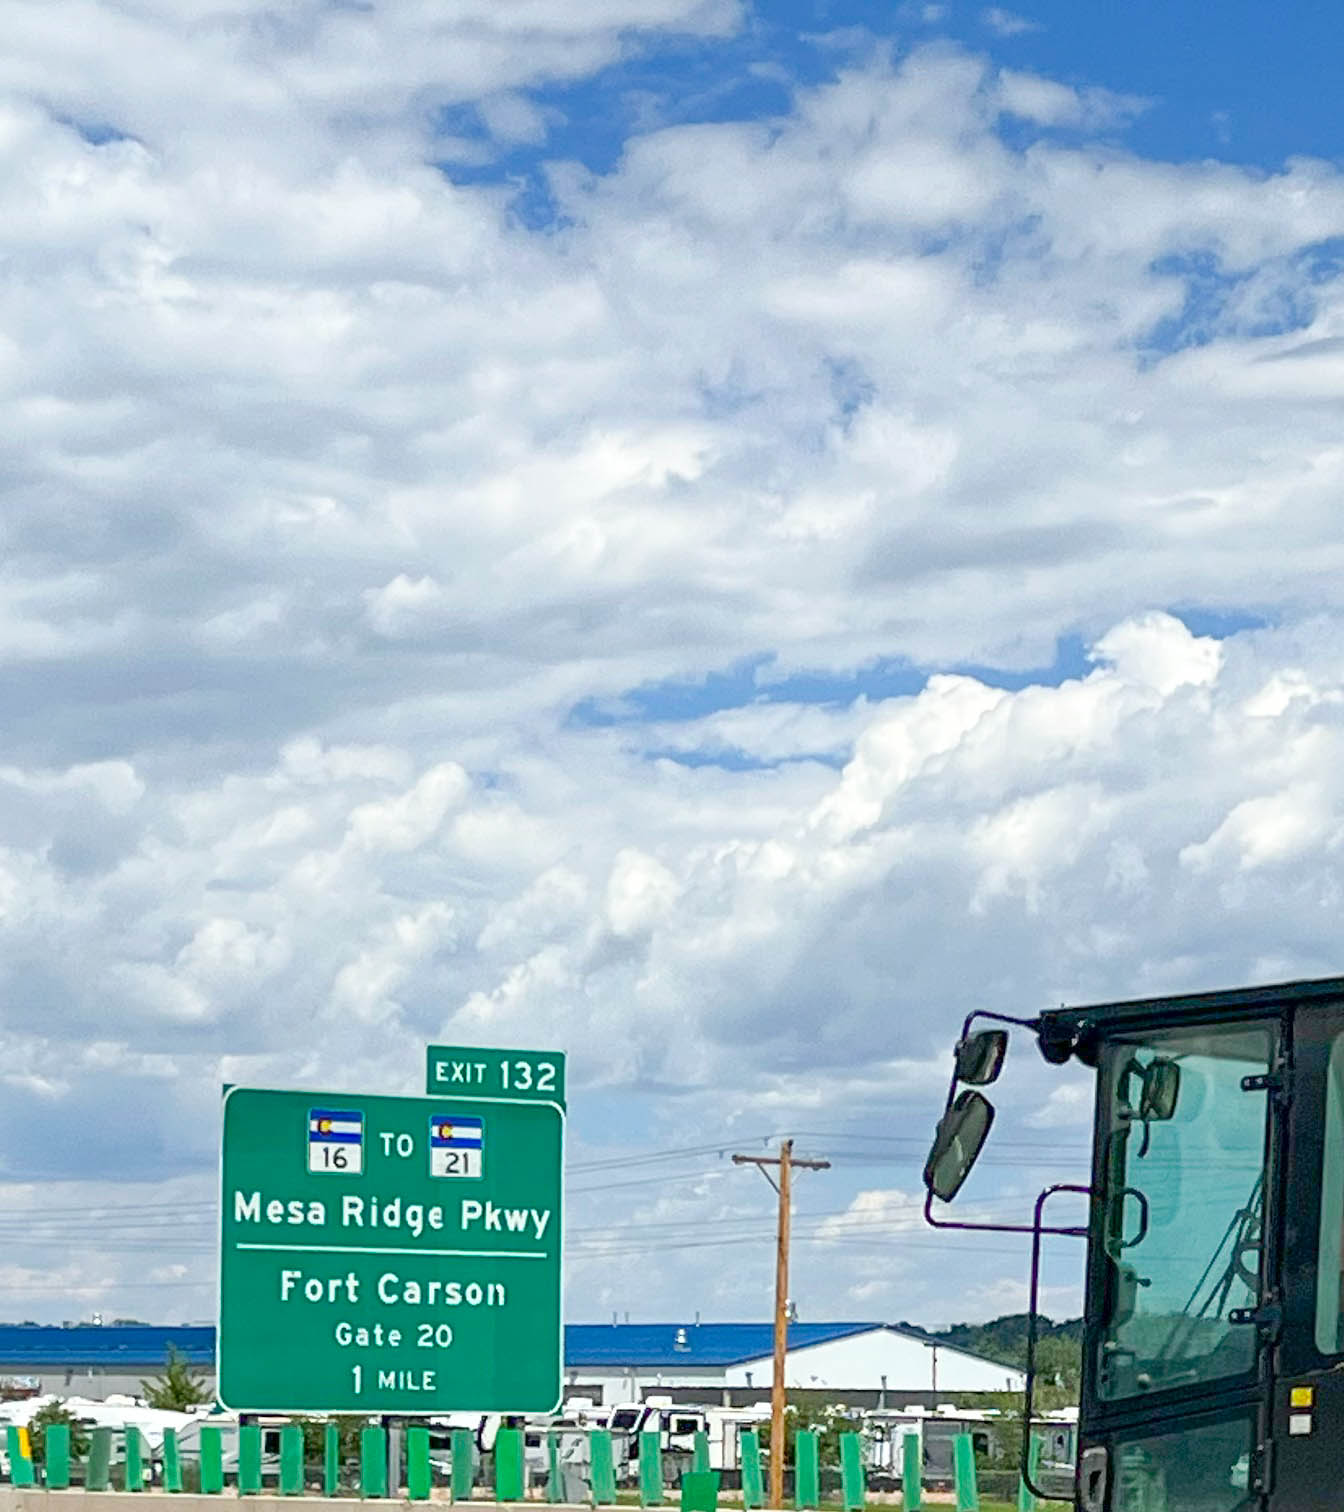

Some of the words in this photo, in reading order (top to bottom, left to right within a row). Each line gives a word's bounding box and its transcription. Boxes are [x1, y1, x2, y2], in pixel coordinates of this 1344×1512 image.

[435, 1062, 487, 1083] EXIT
[500, 1061, 556, 1092] 132
[321, 1147, 348, 1169] 16
[379, 1132, 414, 1157] TO
[444, 1152, 469, 1174] 21
[234, 1191, 325, 1226] Mesa
[342, 1196, 444, 1237] Ridge
[461, 1200, 550, 1240] Pkwy
[281, 1270, 360, 1302] Fort
[378, 1273, 505, 1306] Carson
[335, 1322, 402, 1347] Gate
[417, 1324, 453, 1348] 20
[352, 1365, 362, 1394] 1
[378, 1371, 436, 1391] MILE
